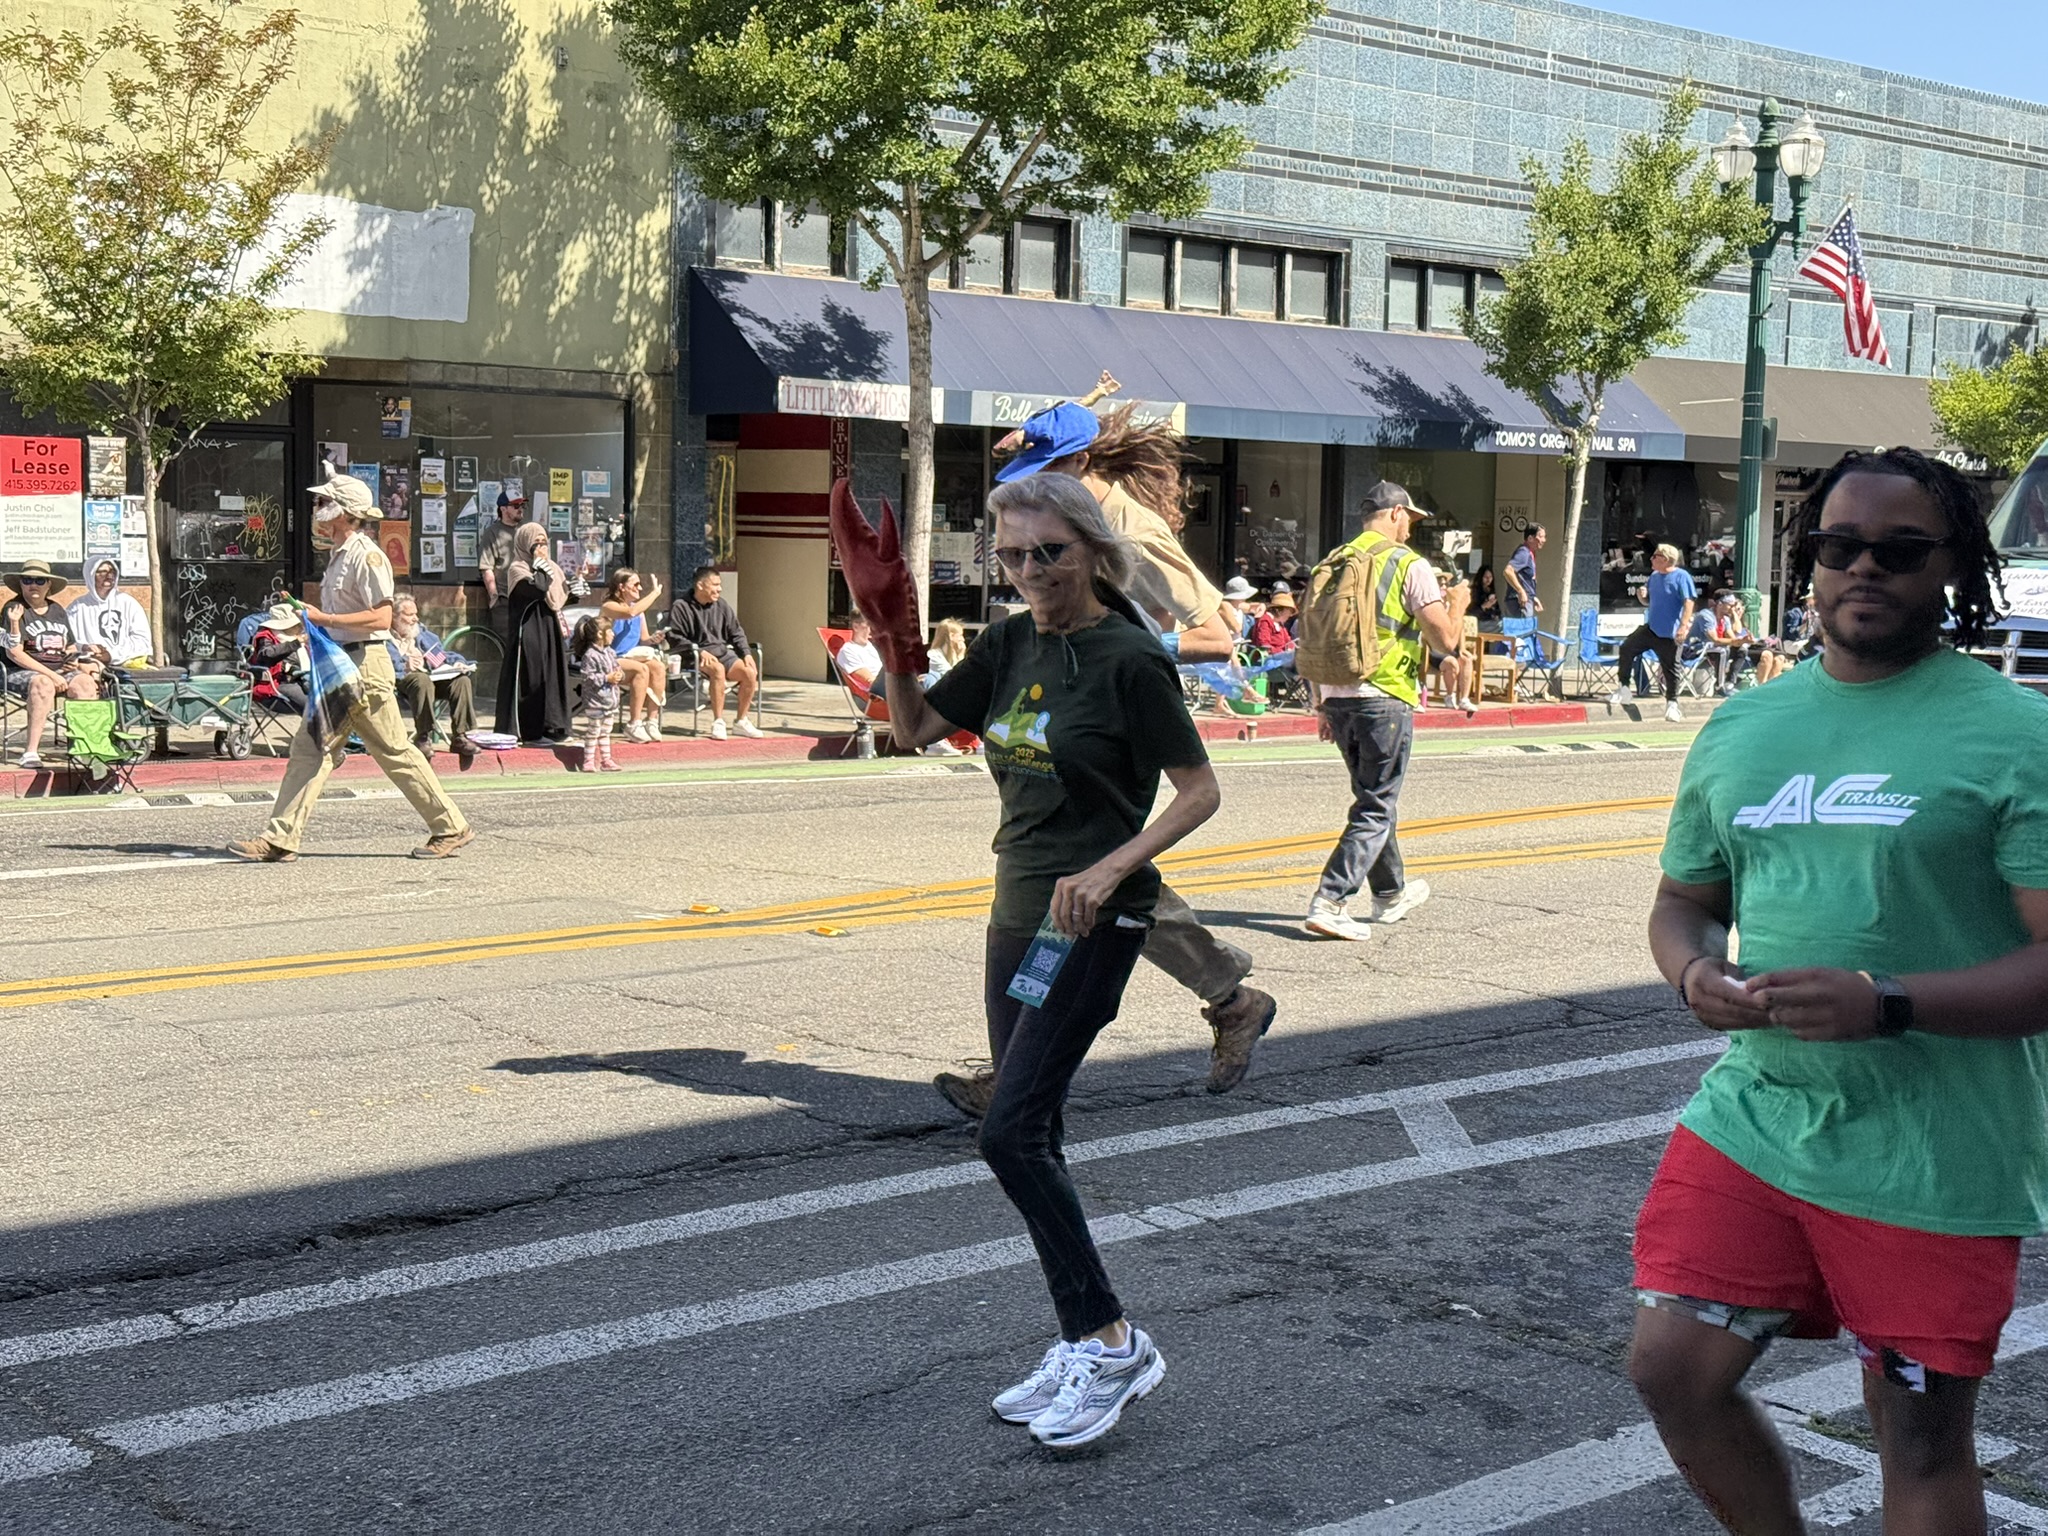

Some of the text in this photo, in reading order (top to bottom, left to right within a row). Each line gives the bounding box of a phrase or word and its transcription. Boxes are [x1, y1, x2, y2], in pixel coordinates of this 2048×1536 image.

[785, 383, 836, 412] LITTLE
[838, 386, 898, 417] PSYCHIC
[995, 396, 1035, 423] Bell
[24, 440, 58, 456] For
[1495, 431, 1637, 452] TOMO'S ORGA NAIL SPA
[12, 458, 70, 475] Lease
[4, 479, 77, 491] 415.395.7262
[4, 503, 55, 512] Justin Choi
[4, 525, 71, 534] Jeff Badstubner
[1627, 586, 1636, 596] 10
[25, 619, 46, 637] OLD
[1016, 747, 1036, 759] 2025
[1732, 774, 1917, 828] AC
[1842, 791, 1921, 808] TRANSIT
